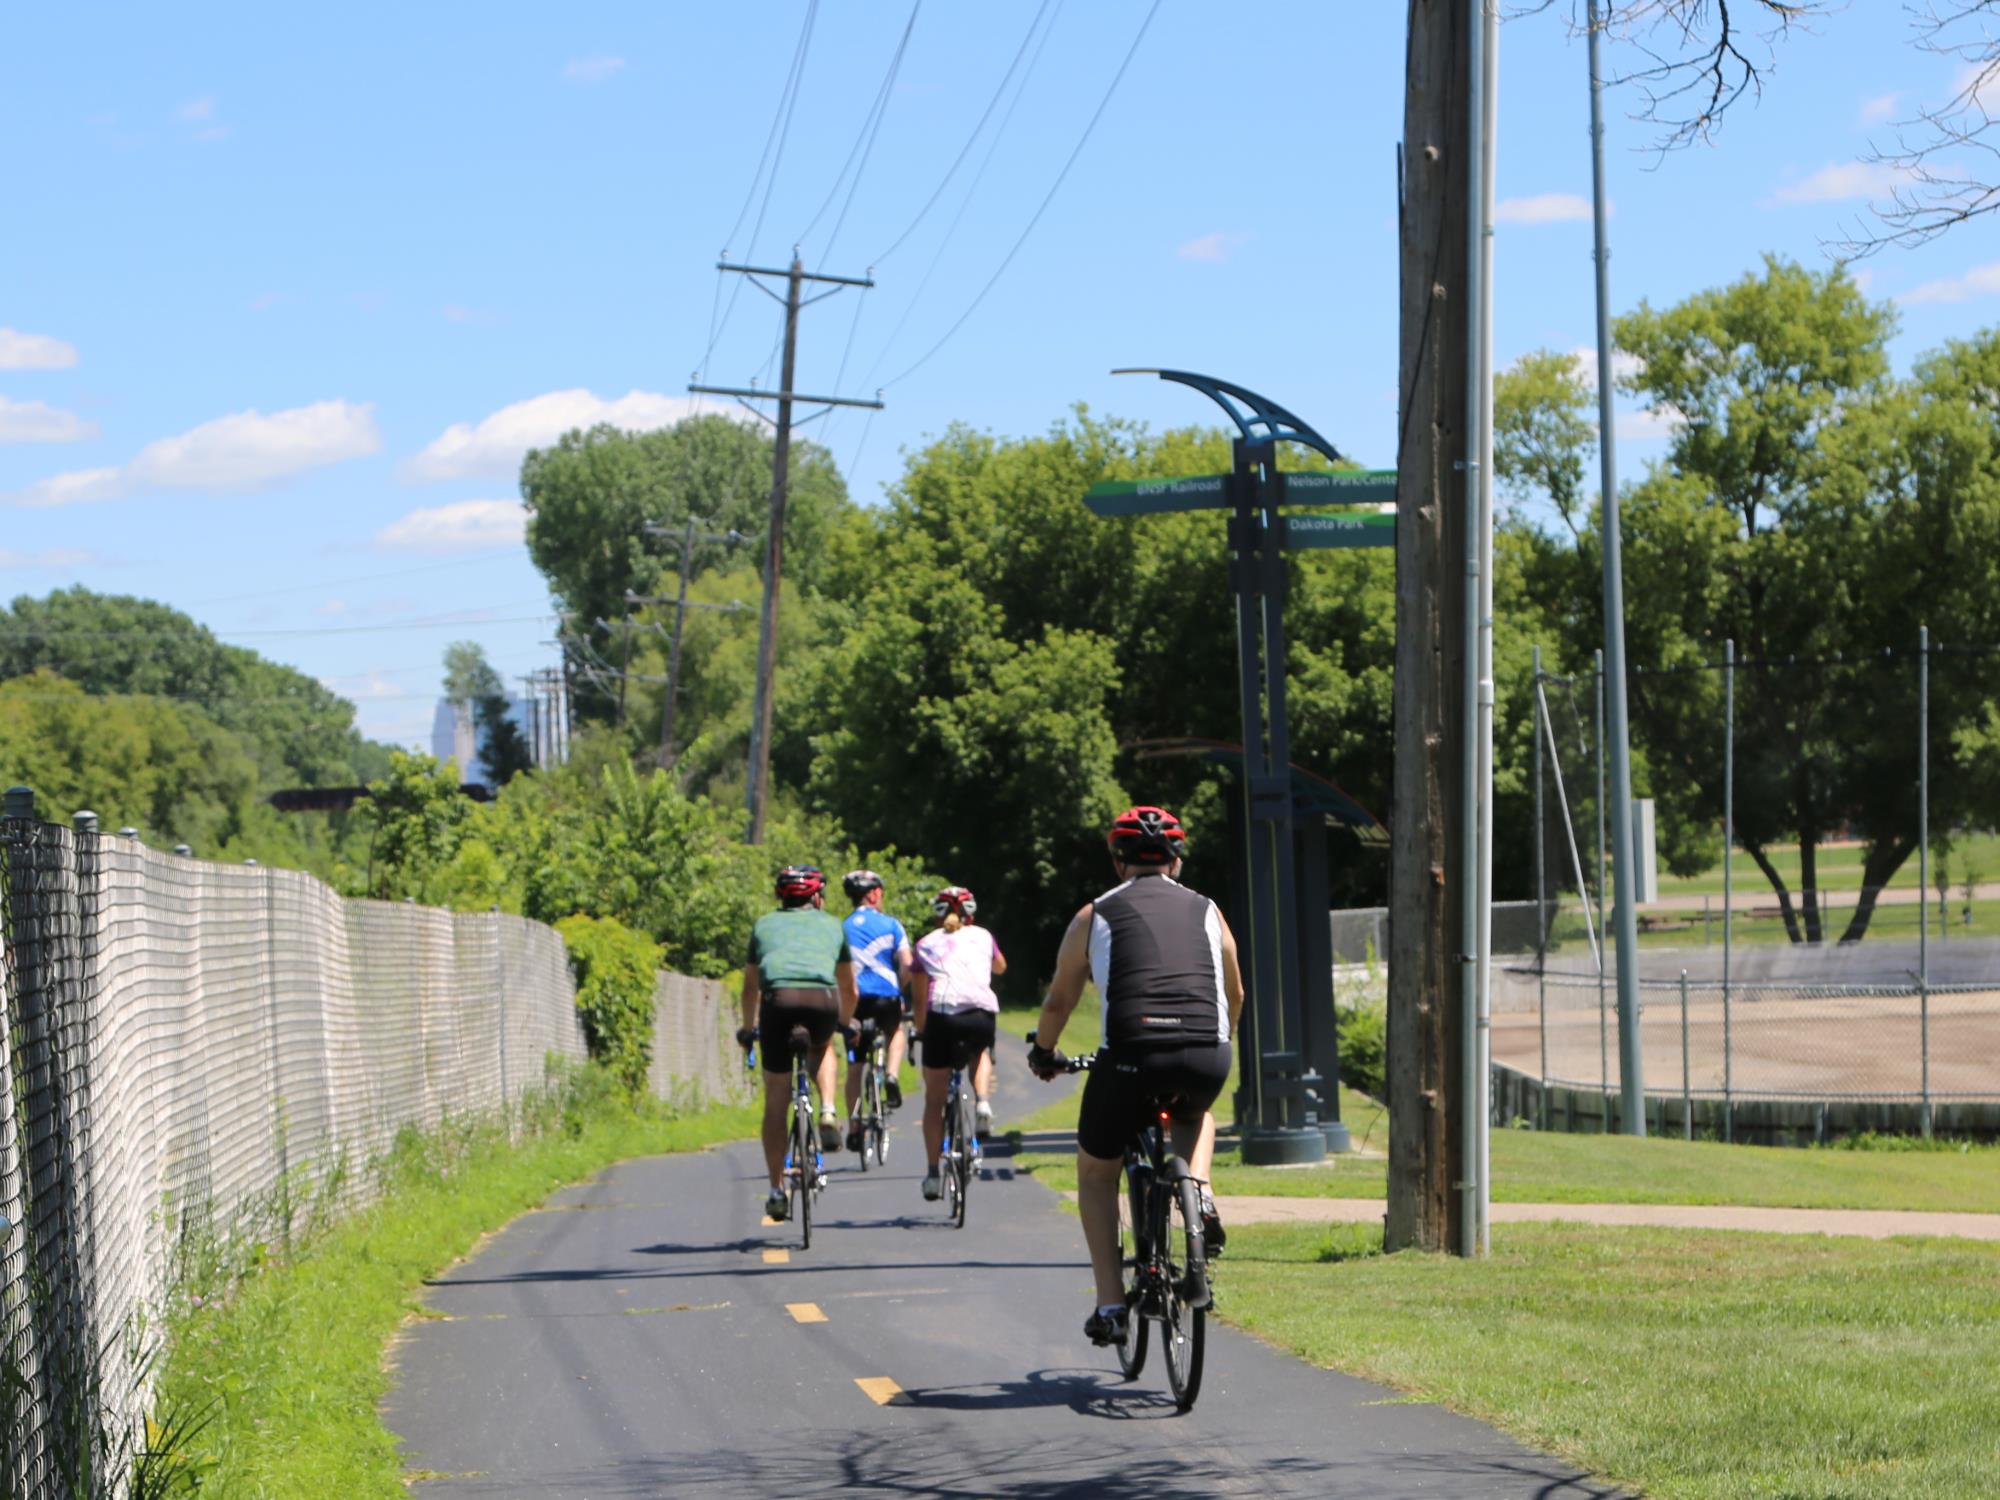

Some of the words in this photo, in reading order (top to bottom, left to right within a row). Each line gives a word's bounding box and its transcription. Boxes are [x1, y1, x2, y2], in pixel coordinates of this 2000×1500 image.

[1170, 478, 1222, 493] Railroad
[1287, 475, 1330, 487] Nelson
[1333, 474, 1397, 487] Park/Cente
[1290, 518, 1334, 530] Dakota
[1337, 518, 1364, 529] Park
